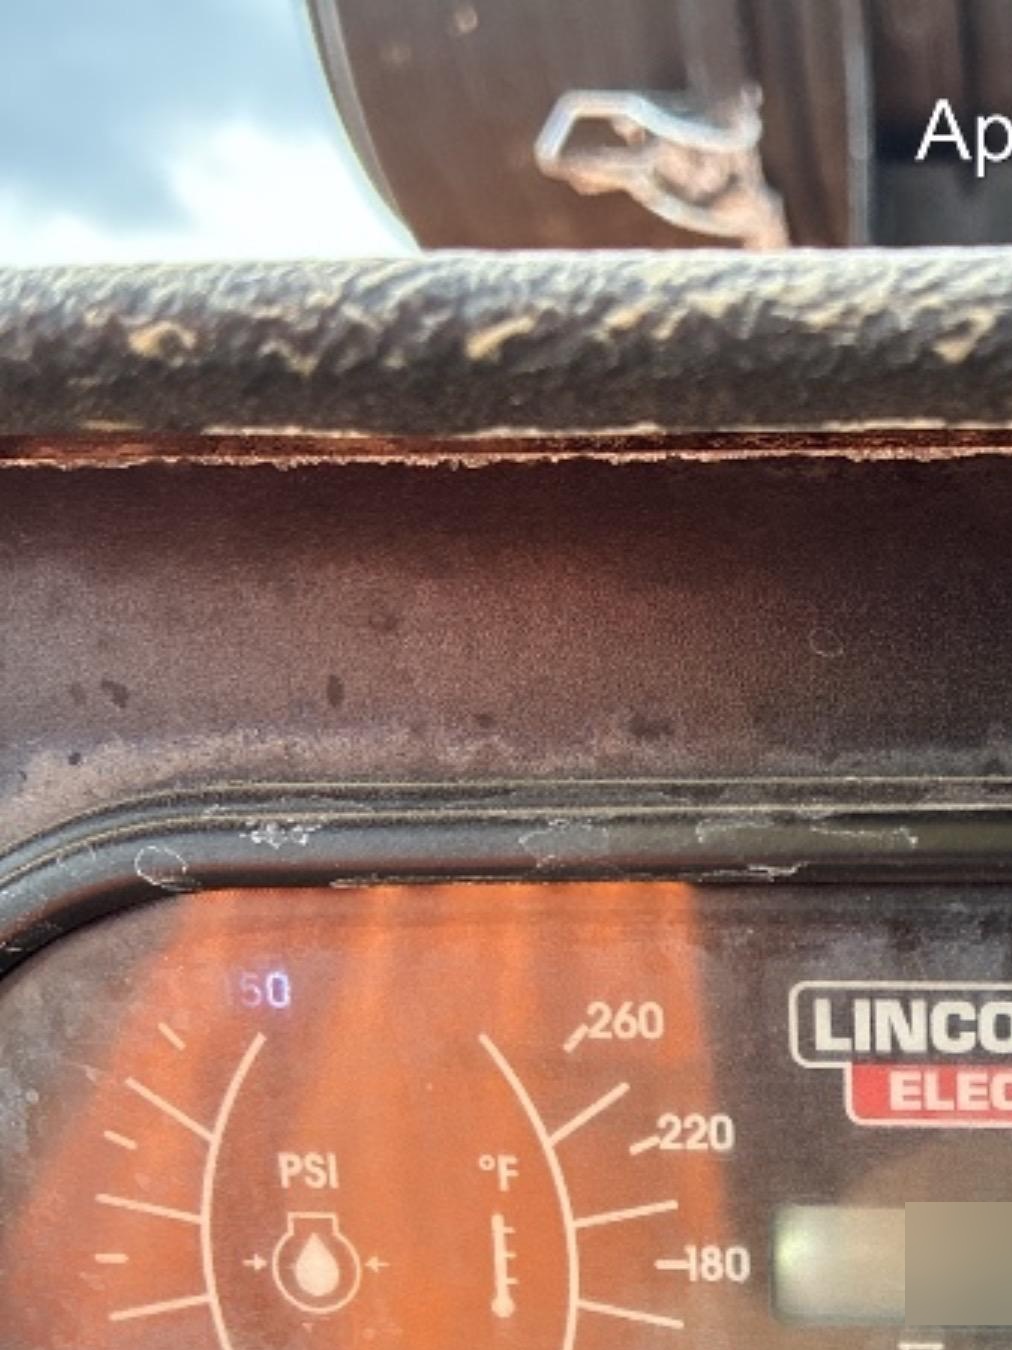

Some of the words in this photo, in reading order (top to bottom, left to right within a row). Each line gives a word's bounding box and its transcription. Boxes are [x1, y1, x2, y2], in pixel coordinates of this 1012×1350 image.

[587, 1002, 664, 1041] 260
[658, 1114, 734, 1153] 220
[278, 1154, 339, 1189] PSI
[687, 1246, 750, 1283] 180
